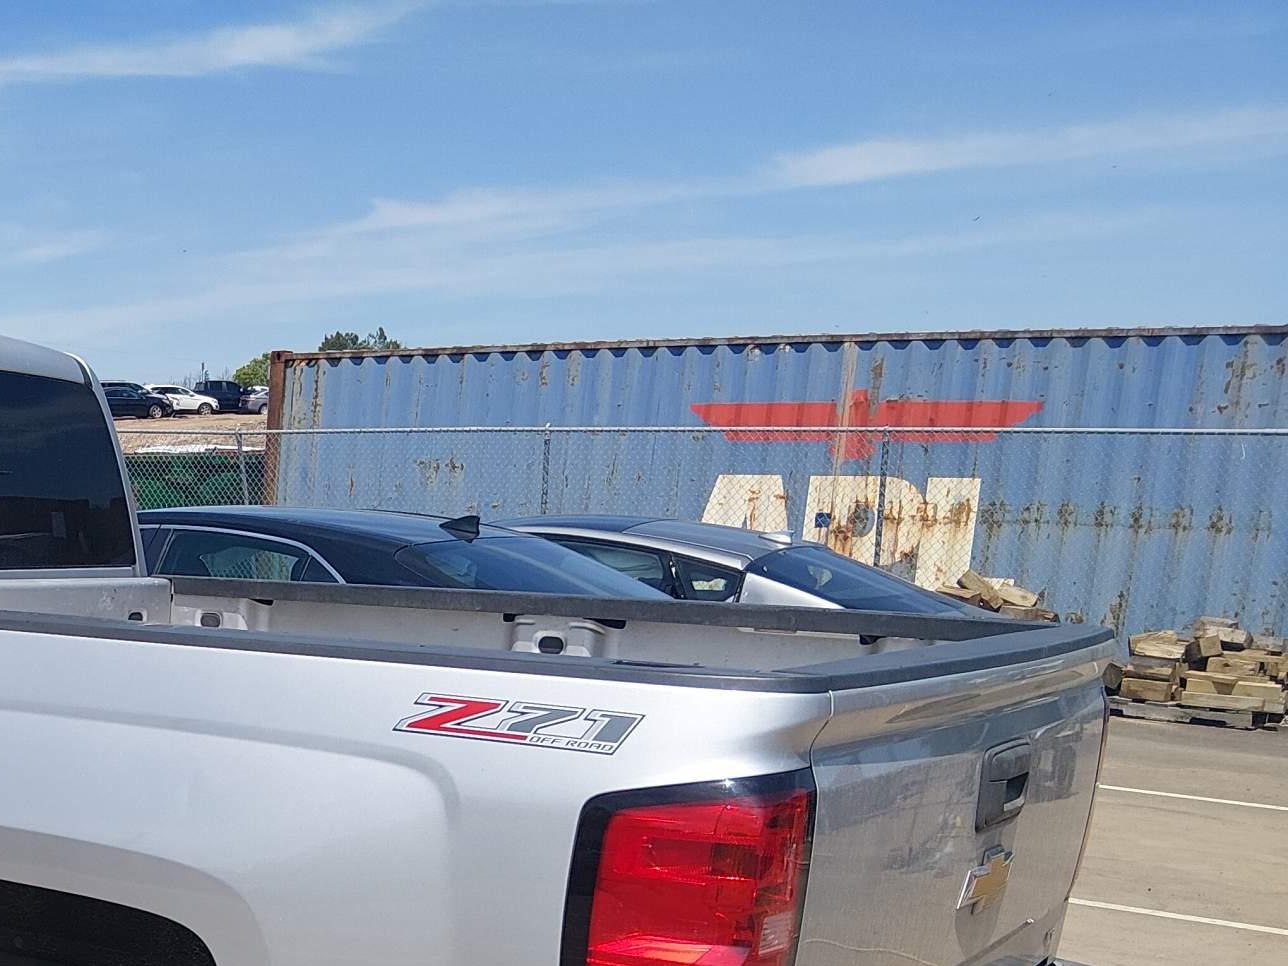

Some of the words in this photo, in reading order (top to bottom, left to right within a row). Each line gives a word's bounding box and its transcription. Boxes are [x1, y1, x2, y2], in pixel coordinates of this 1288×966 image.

[392, 692, 646, 748] Z71
[528, 735, 565, 748] OFF
[564, 738, 614, 752] ROAD
